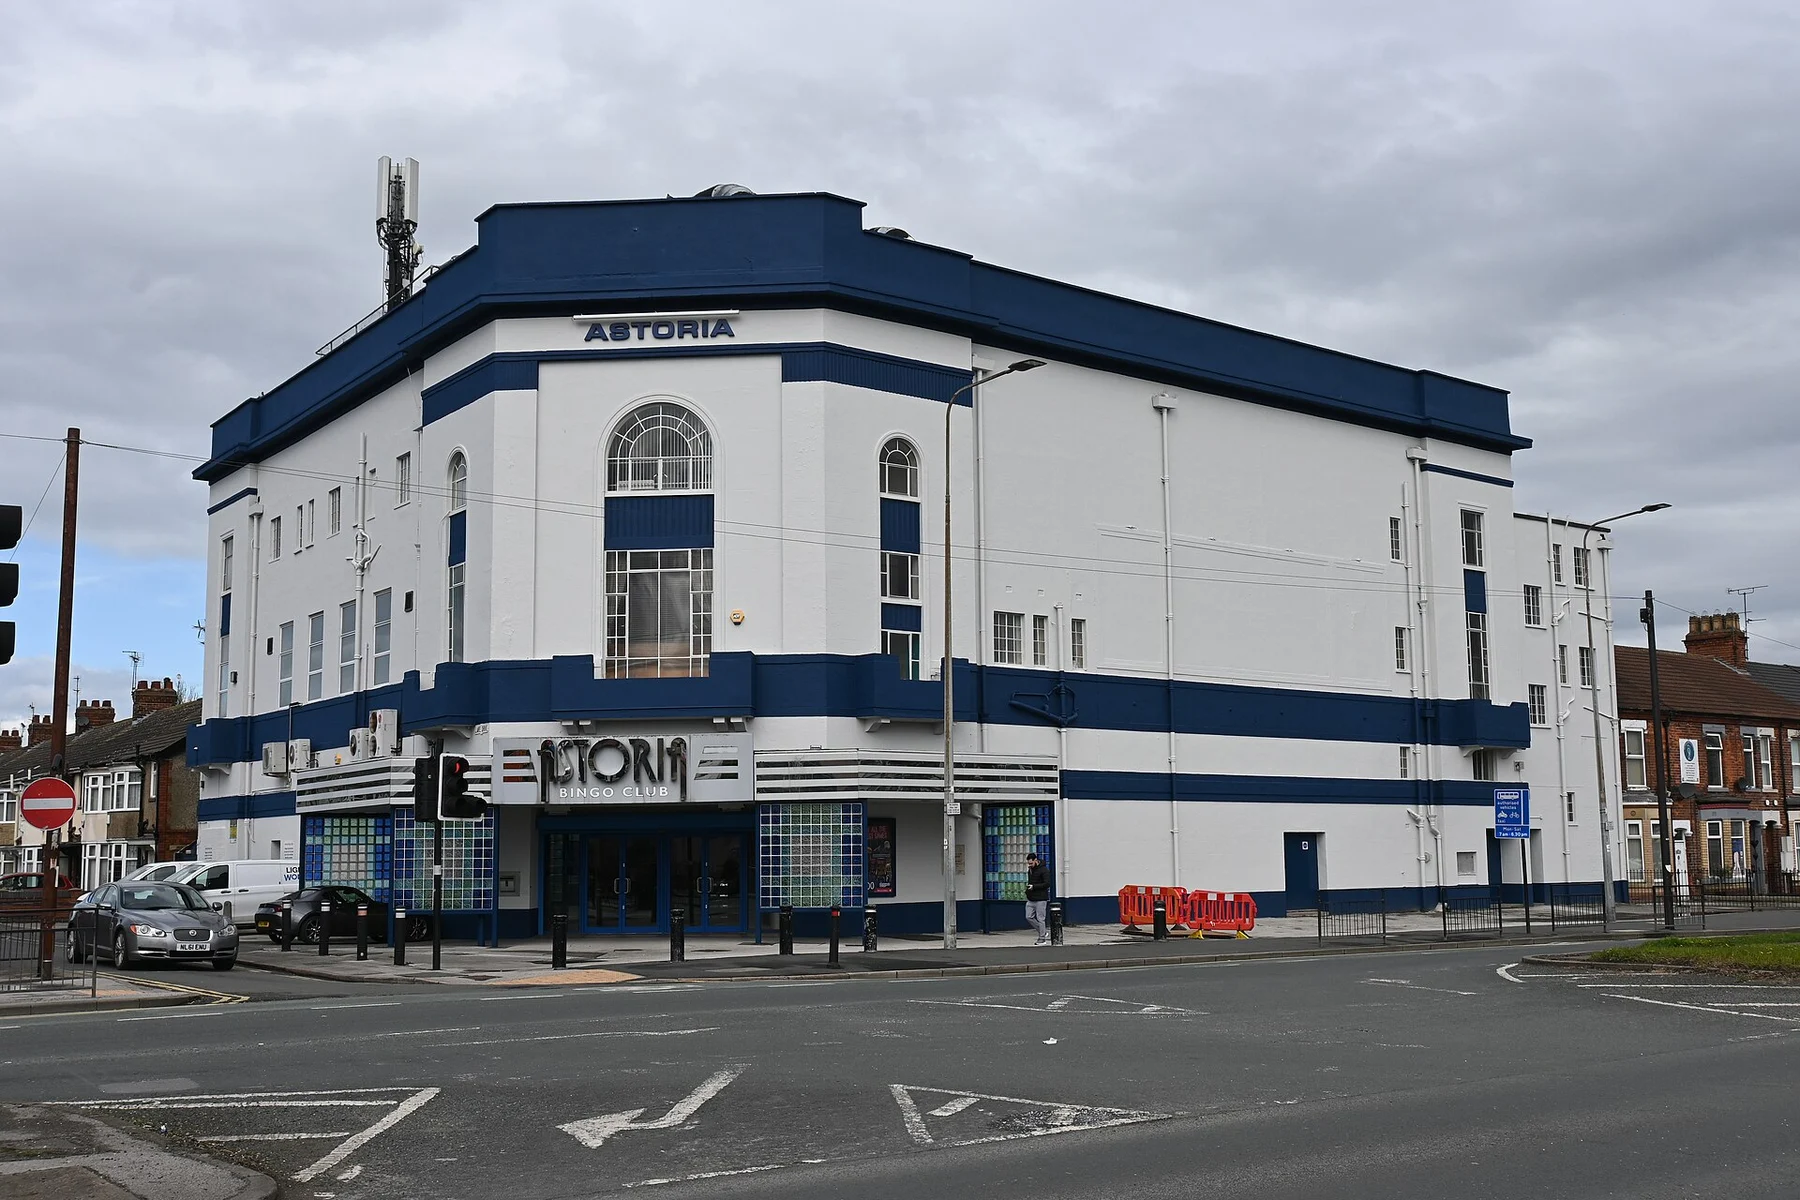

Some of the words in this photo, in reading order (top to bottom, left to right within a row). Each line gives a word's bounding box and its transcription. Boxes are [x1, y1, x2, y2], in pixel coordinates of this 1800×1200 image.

[585, 318, 735, 342] ASTORIA
[537, 737, 687, 802] ASTORIA
[559, 787, 614, 799] BINGO
[622, 786, 669, 798] CLUB
